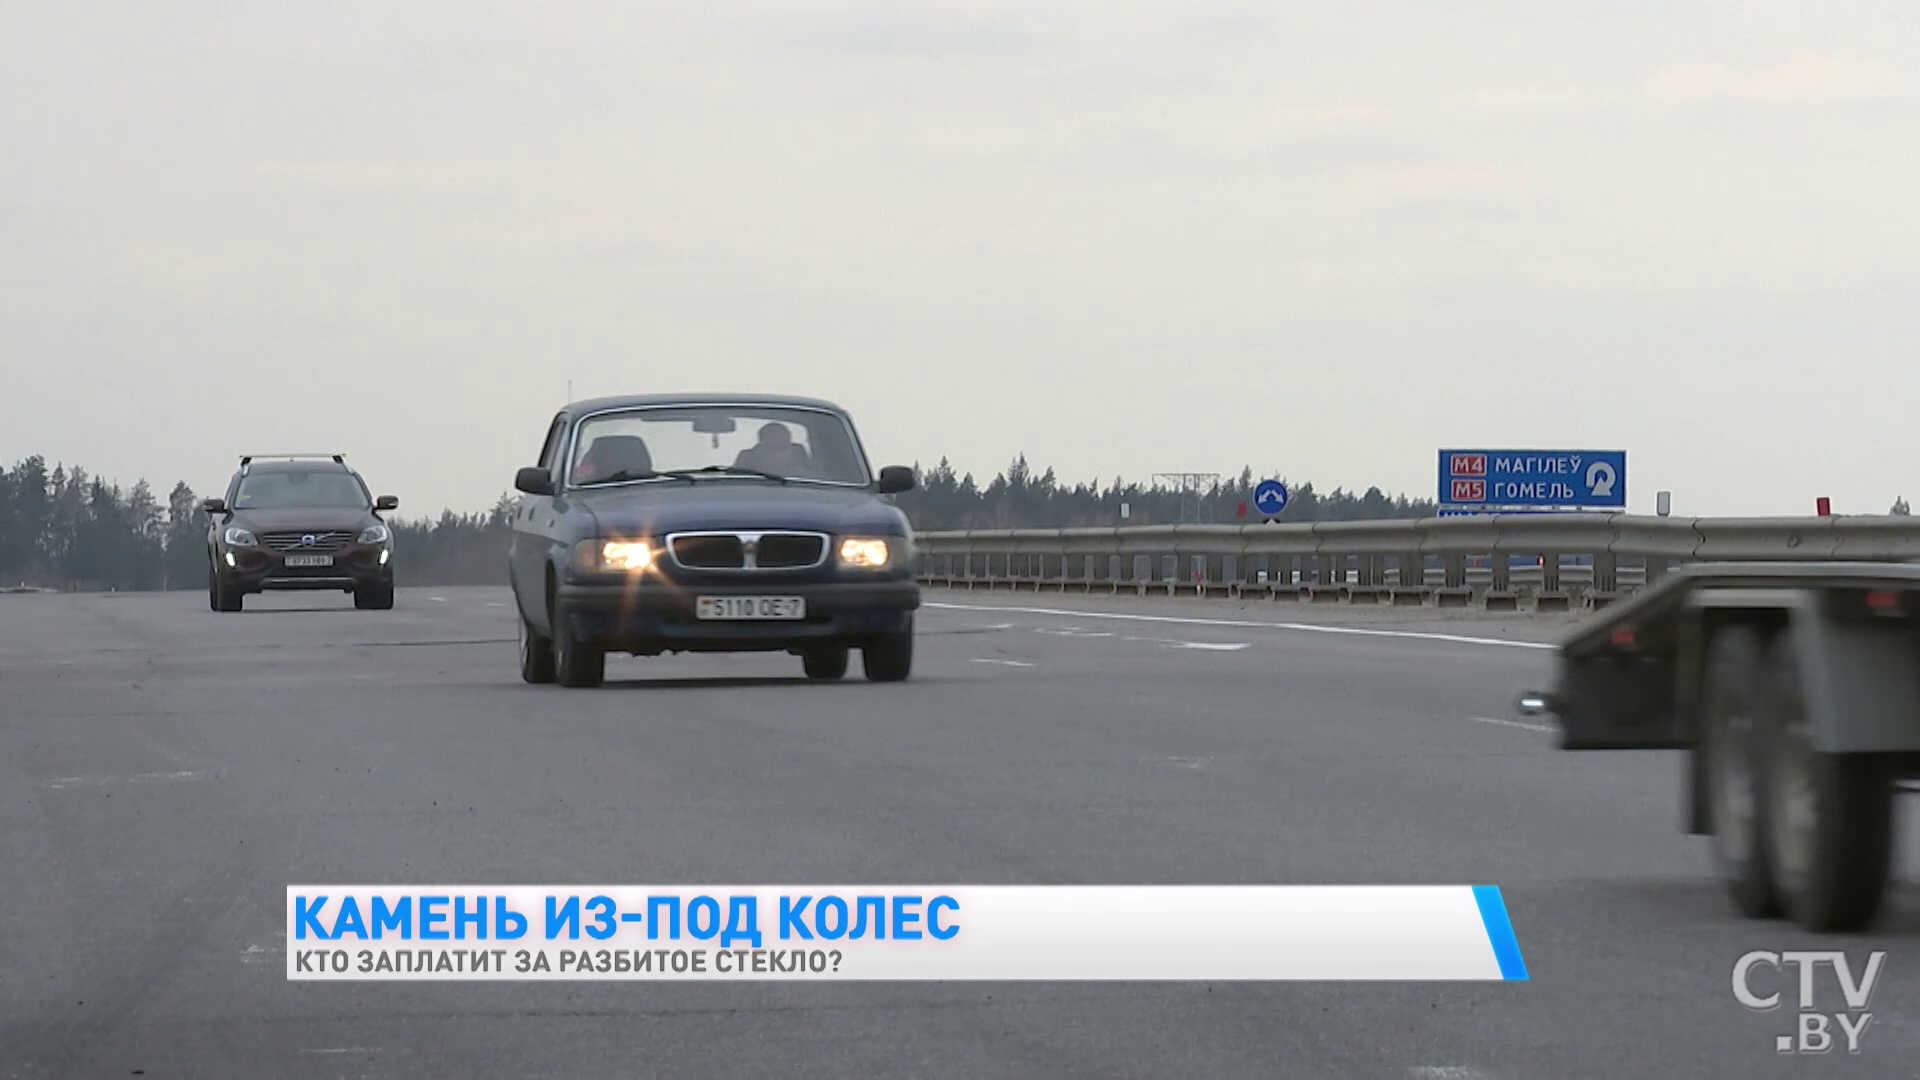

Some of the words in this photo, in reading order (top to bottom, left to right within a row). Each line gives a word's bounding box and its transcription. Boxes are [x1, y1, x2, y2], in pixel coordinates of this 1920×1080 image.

[1453, 457, 1484, 473] М4
[1494, 454, 1582, 474] МАГІЛЕЎ
[1455, 483, 1483, 498] М5
[1494, 482, 1575, 498] ГОМЕЛЬ
[714, 598, 754, 616] 5110
